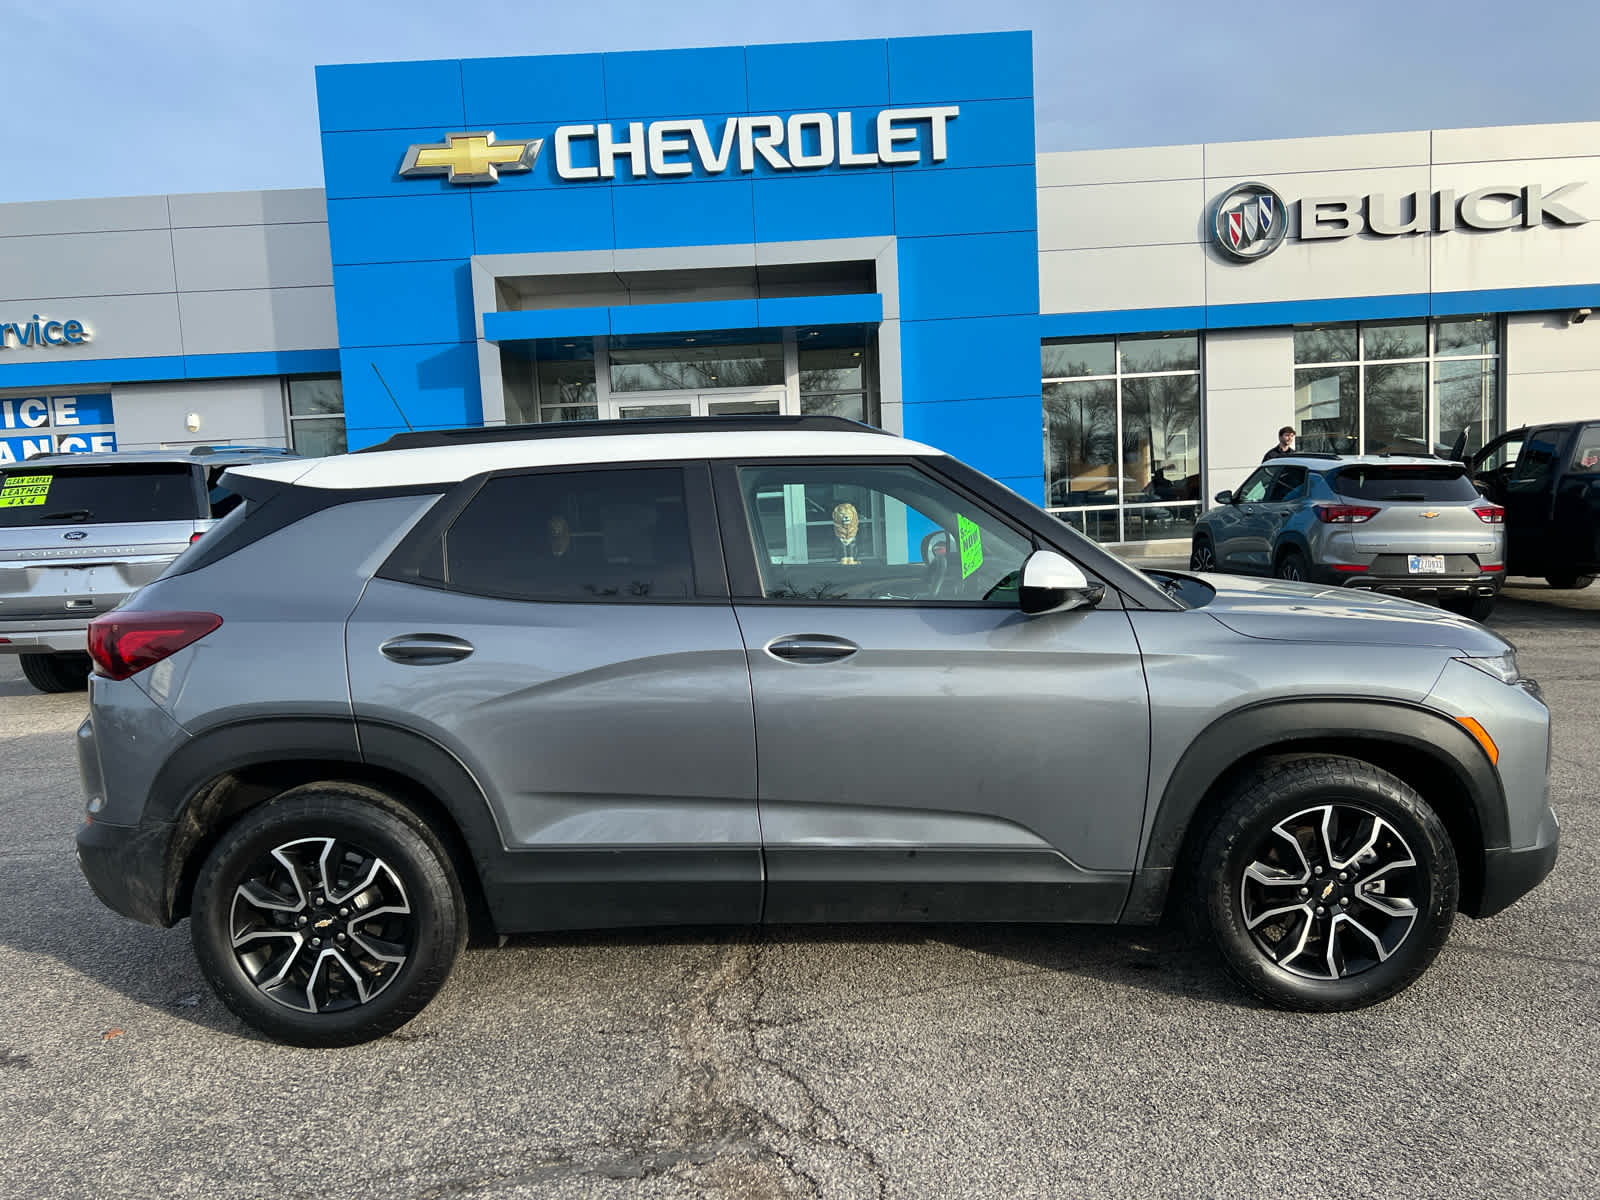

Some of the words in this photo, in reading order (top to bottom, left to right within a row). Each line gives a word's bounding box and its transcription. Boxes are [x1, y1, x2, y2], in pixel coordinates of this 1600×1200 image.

[554, 105, 959, 179] CHEVROLET
[1300, 181, 1589, 240] BUICK
[3, 397, 80, 429] ICE
[2, 485, 48, 498] LEATHER
